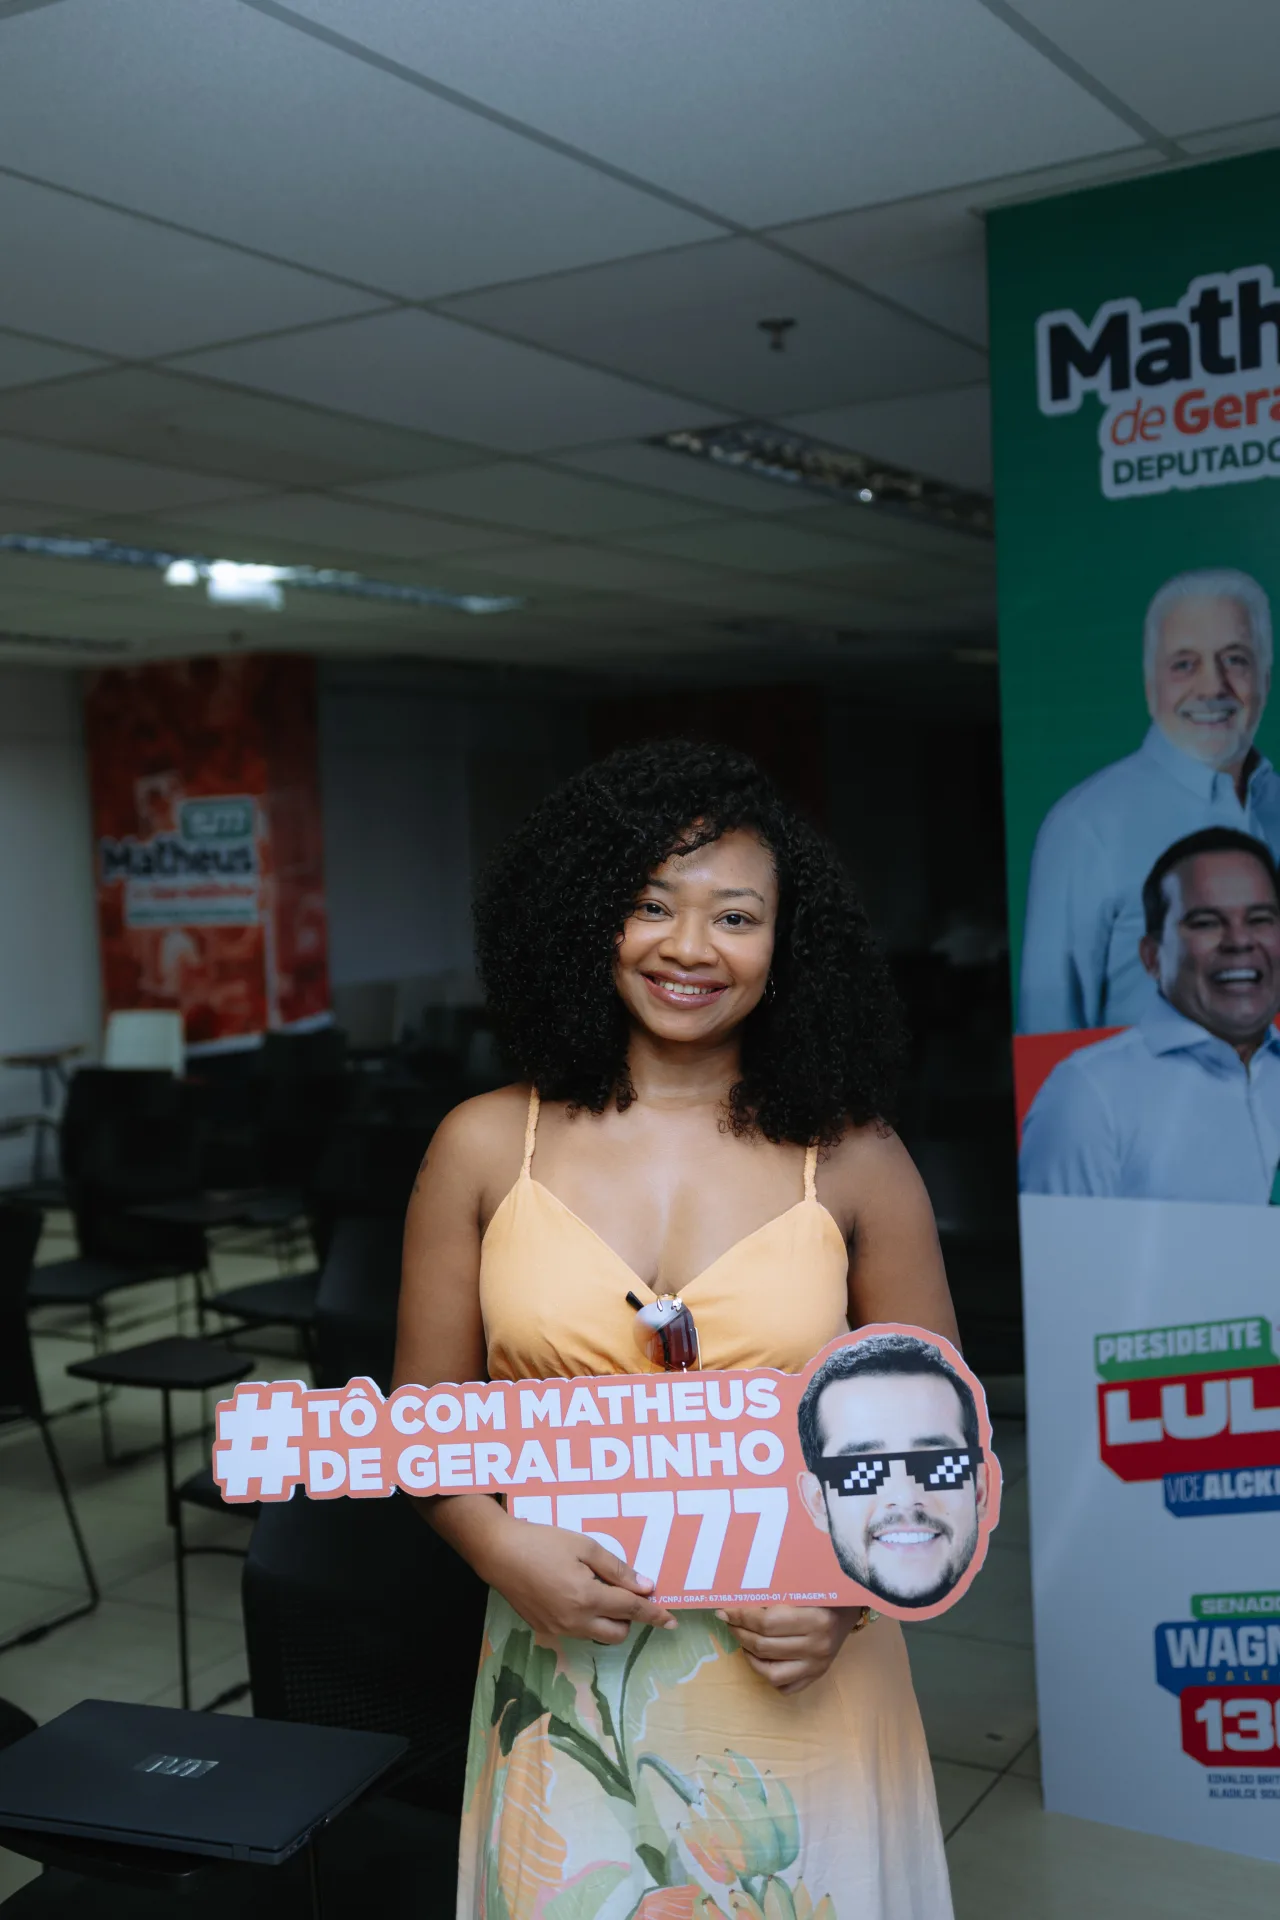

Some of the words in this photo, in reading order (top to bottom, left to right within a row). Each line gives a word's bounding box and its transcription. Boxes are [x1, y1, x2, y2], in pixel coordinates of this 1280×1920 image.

[1111, 397, 1166, 446] de
[1099, 1320, 1261, 1365] PRESIDENTE
[390, 1391, 506, 1435] COM
[519, 1378, 781, 1429] MATHEUS
[1104, 1376, 1280, 1446] LUL
[308, 1447, 383, 1492] DE
[397, 1430, 785, 1489] GERALDINHO
[1203, 1468, 1280, 1500] ALCK
[829, 1592, 838, 1600] 10
[1195, 1698, 1280, 1752] 13
